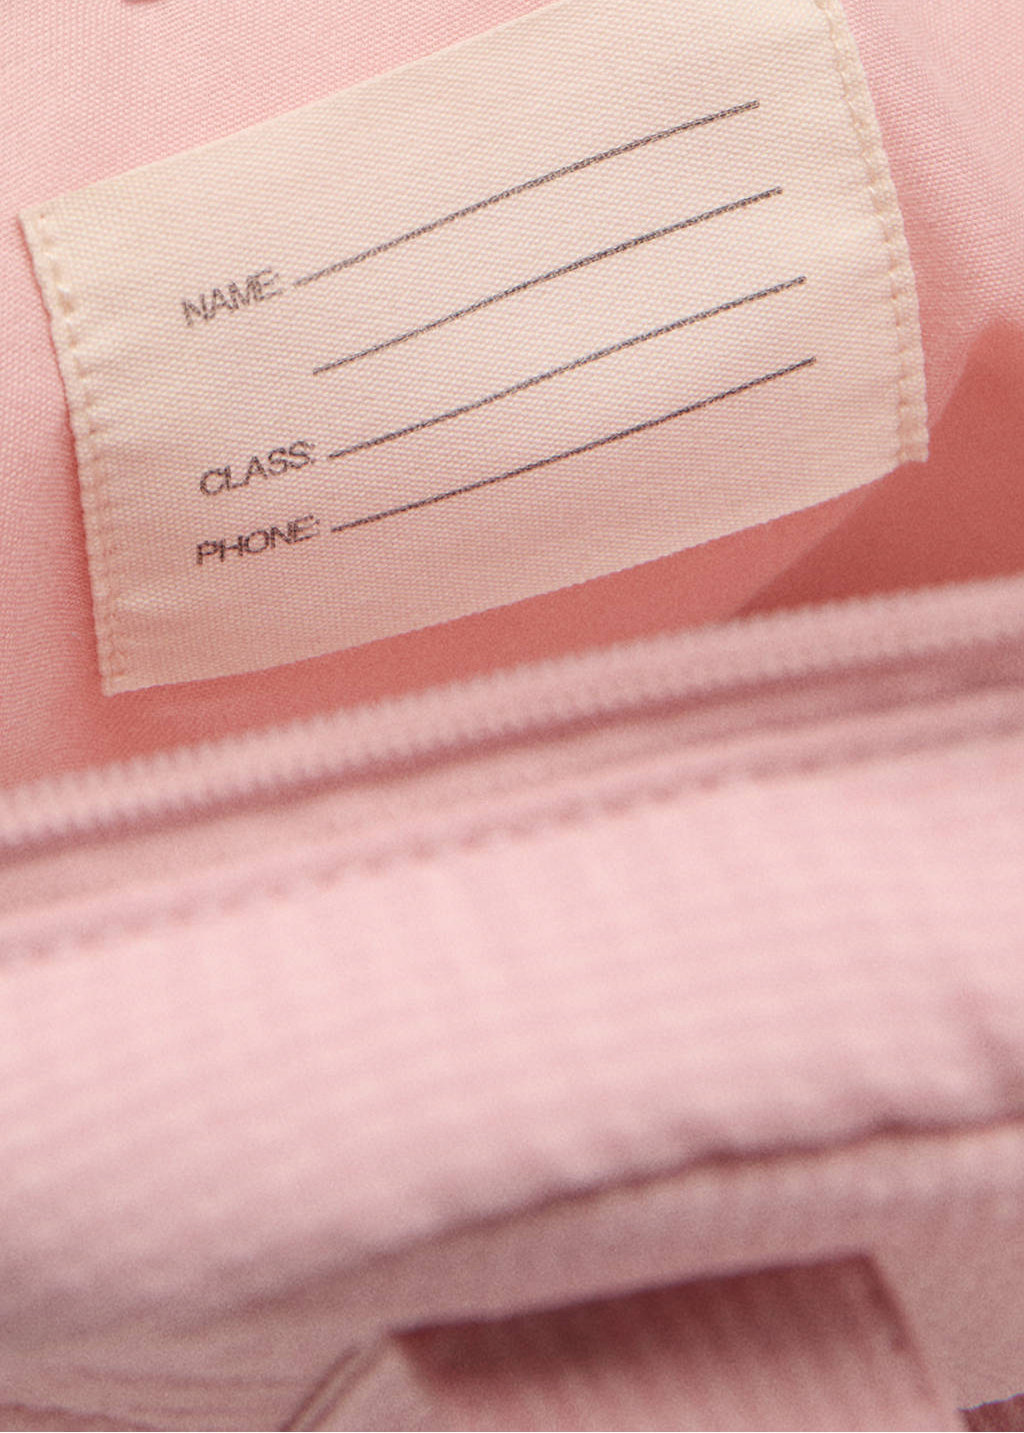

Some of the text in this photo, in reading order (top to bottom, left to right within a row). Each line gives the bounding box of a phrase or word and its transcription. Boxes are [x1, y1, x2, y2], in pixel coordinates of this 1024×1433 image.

[181, 268, 285, 326] NAME:
[199, 440, 315, 496] CLASS:
[196, 515, 320, 565] PHONE:
